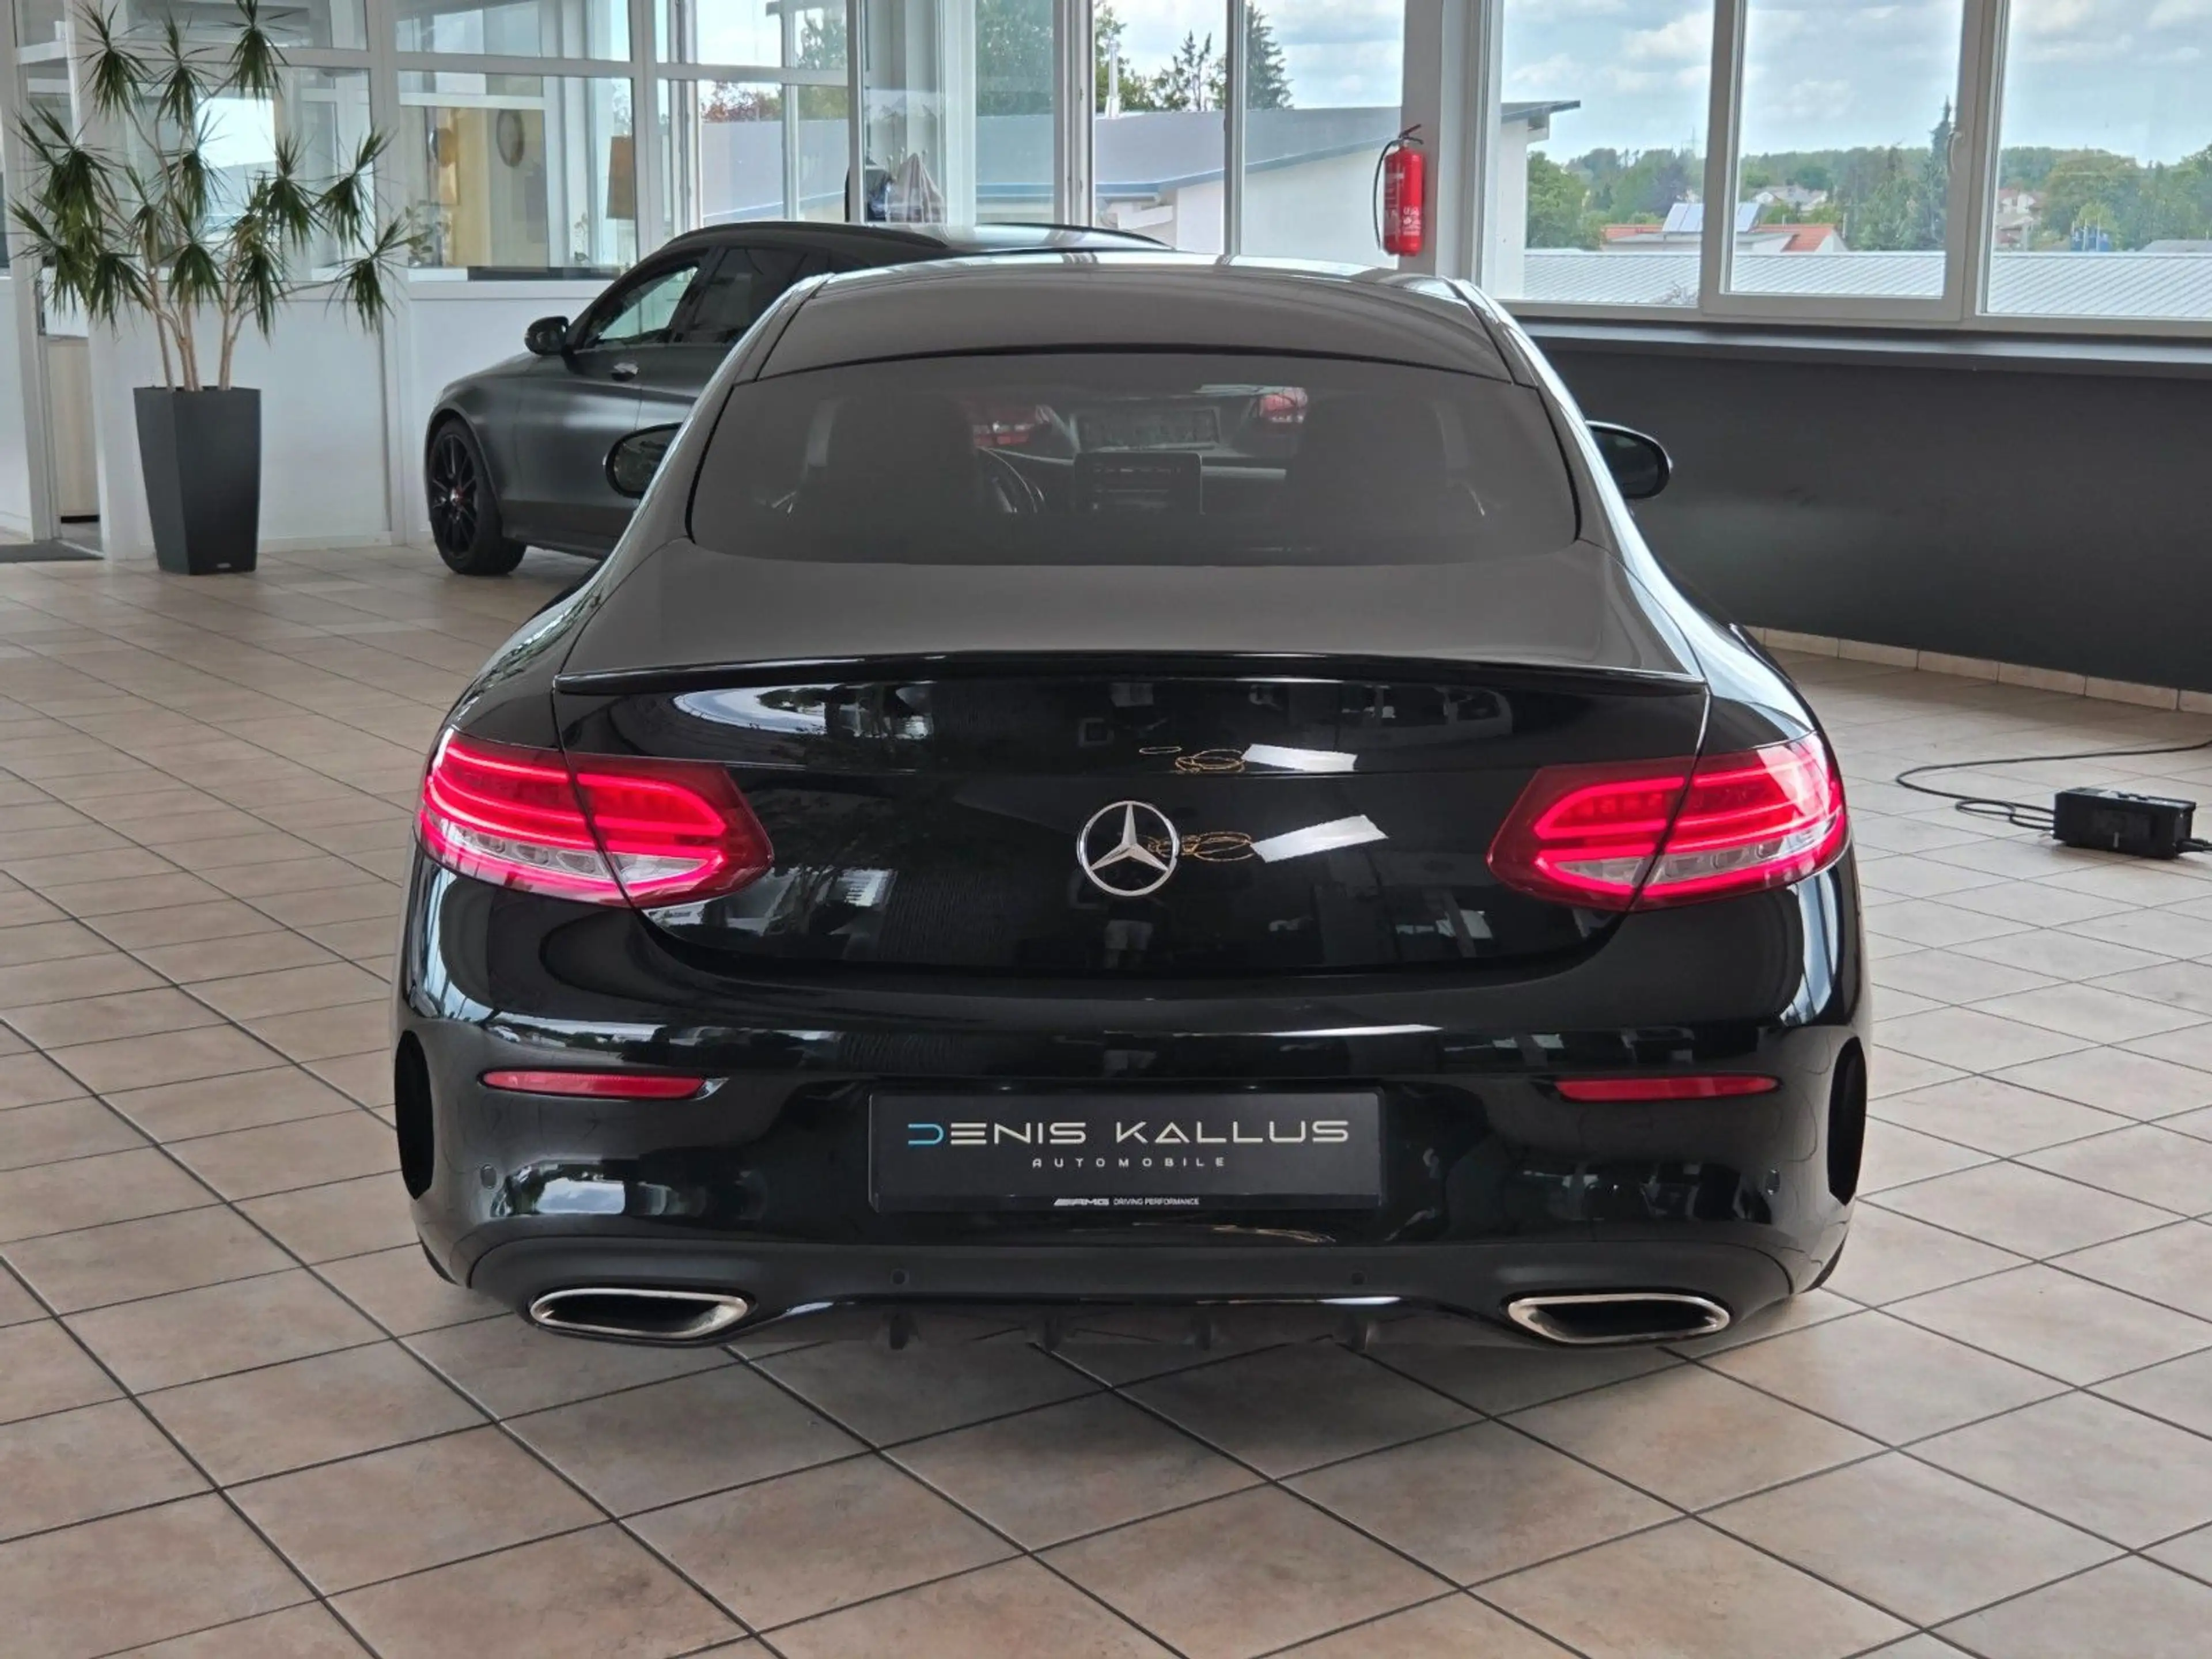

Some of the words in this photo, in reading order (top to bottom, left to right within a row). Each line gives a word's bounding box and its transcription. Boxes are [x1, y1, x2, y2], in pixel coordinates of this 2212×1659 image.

[907, 1122, 1086, 1145] DENIS
[1116, 1120, 1350, 1144] KALLUS
[1032, 1157, 1224, 1168] AUTOMOBILE
[1113, 1198, 1143, 1206] DRIVING
[1145, 1198, 1199, 1206] PERFORMANCE
